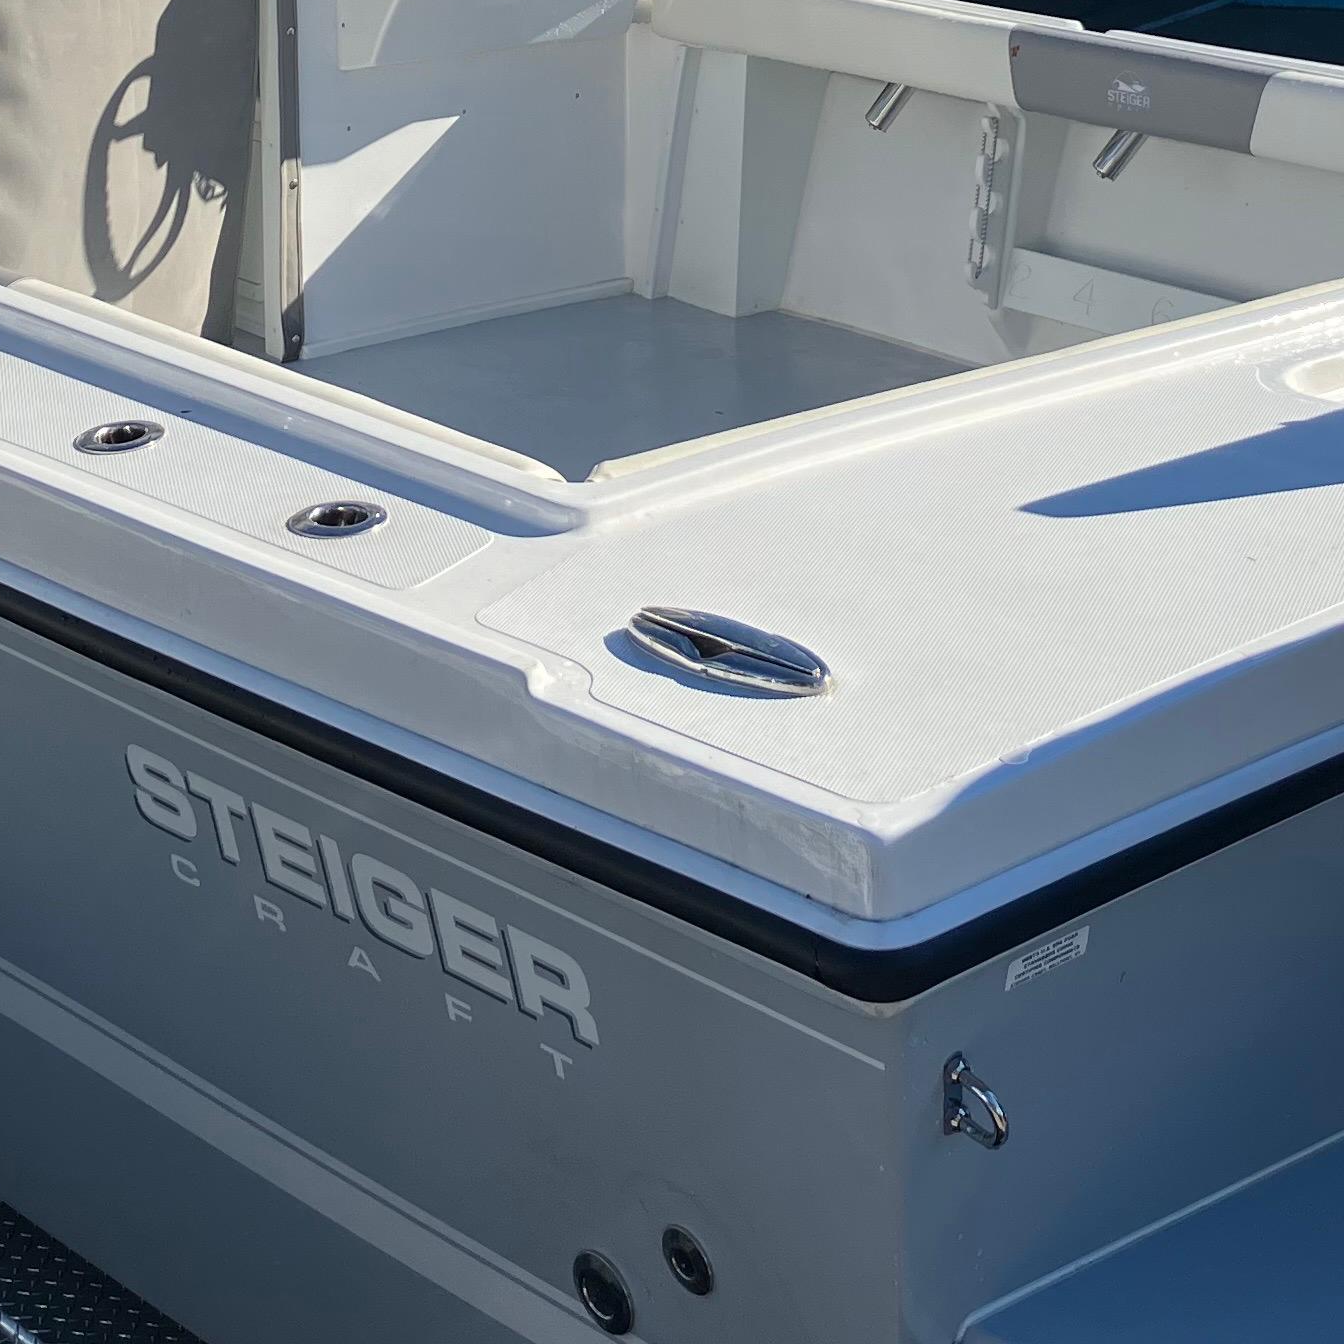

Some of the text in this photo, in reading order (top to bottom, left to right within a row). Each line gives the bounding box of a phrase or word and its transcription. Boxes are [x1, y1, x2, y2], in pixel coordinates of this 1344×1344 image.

[1107, 89, 1151, 109] STEIGER
[1073, 277, 1095, 316] 4
[125, 743, 600, 1050] STEIGER
[170, 853, 574, 1080] CRAFT
